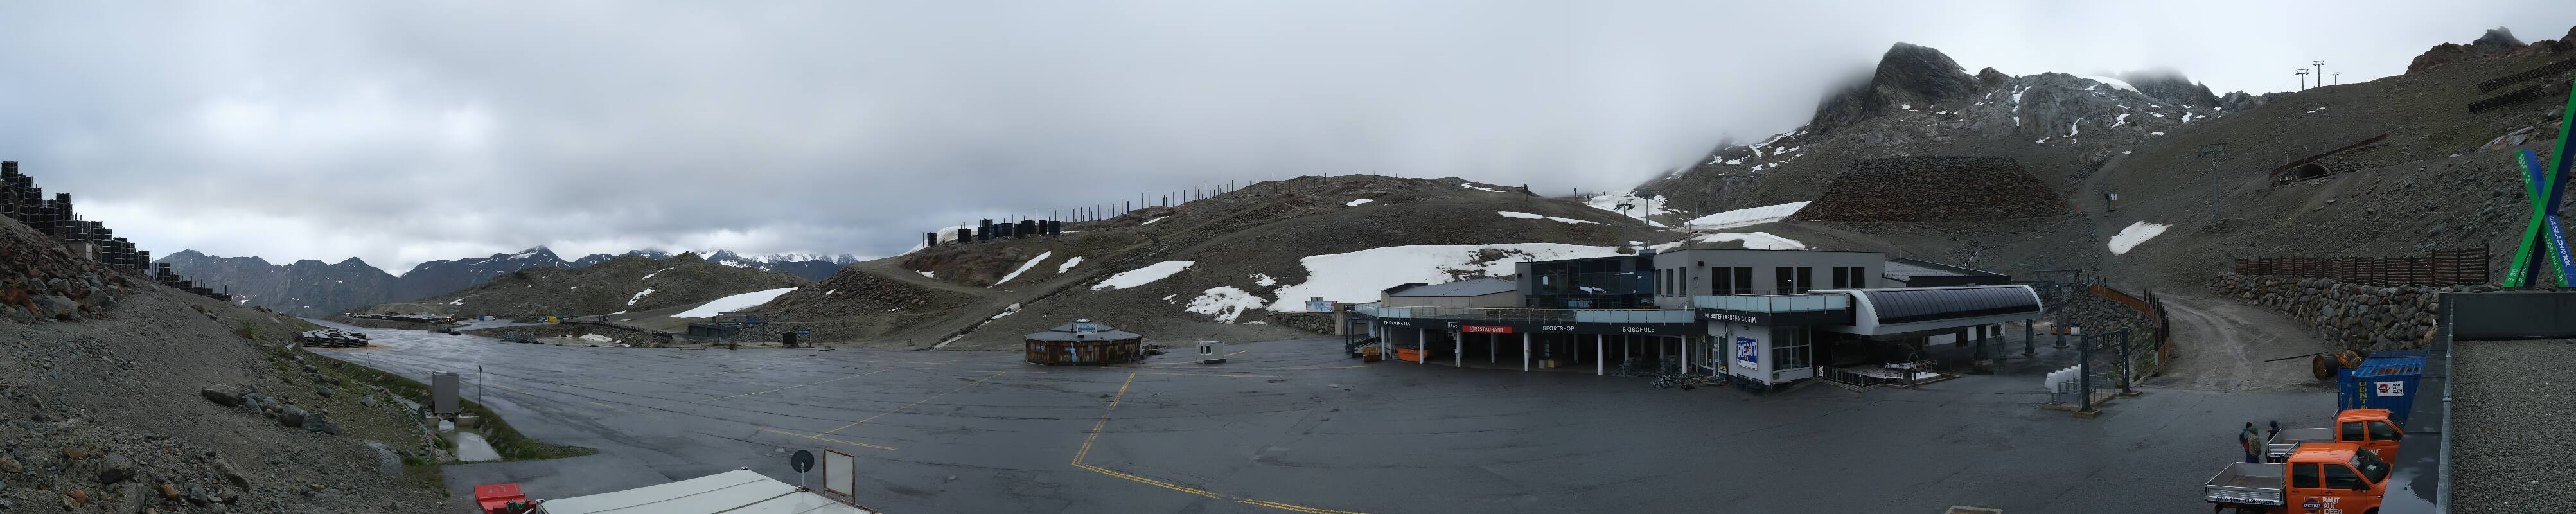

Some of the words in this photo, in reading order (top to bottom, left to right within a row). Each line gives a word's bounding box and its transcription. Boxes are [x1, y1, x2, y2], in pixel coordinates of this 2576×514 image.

[2518, 154, 2528, 175] BIG
[2525, 175, 2531, 184] 3
[2549, 215, 2572, 267] GAISLACHKOGL
